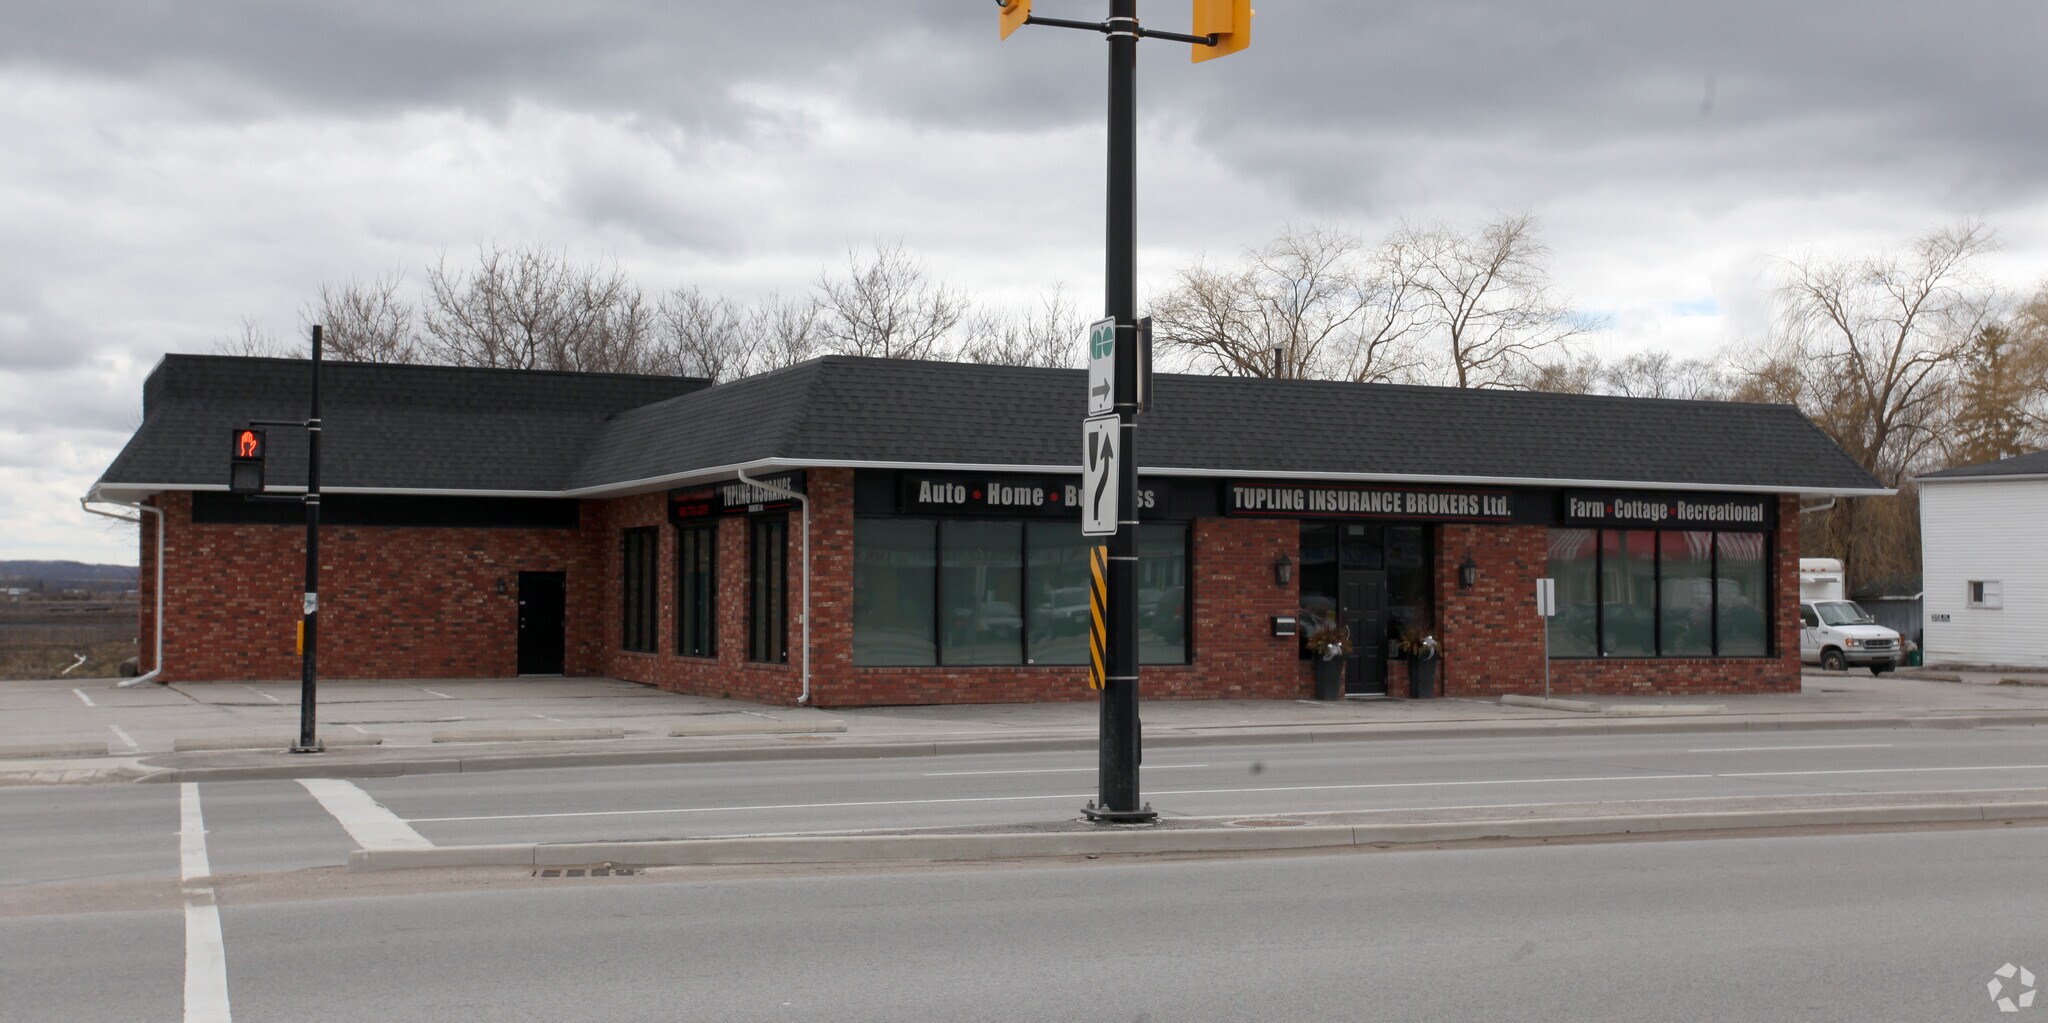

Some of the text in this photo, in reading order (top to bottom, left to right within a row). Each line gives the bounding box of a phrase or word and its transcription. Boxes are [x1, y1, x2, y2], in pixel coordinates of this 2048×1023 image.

[1091, 325, 1114, 361] GO
[723, 483, 751, 507] TUPLING
[918, 481, 966, 504] Auto
[987, 483, 1044, 506] Home
[1233, 487, 1511, 516] TUPLING INSURANCE BROKERS Ltd.
[1570, 498, 1763, 522] Farm Cottage Recreational
